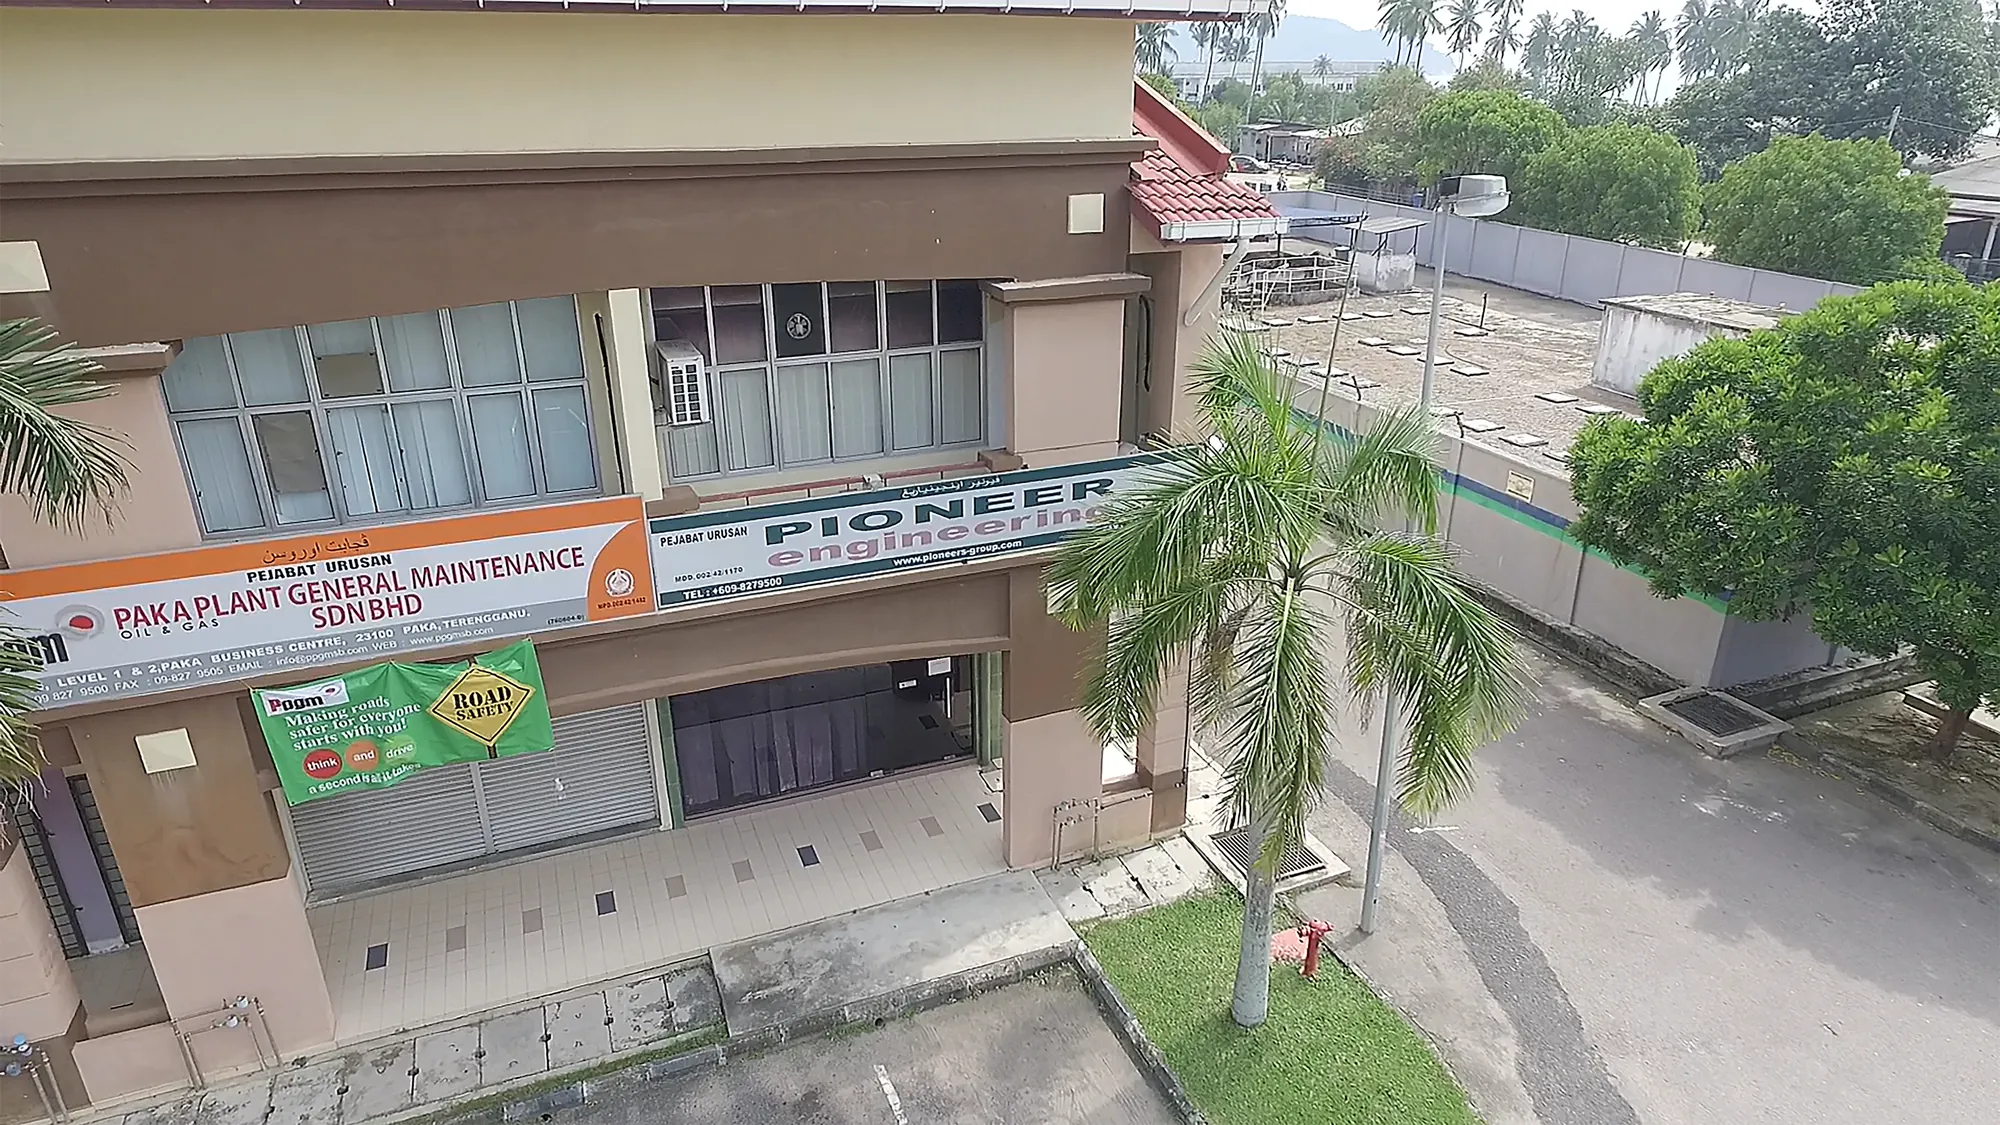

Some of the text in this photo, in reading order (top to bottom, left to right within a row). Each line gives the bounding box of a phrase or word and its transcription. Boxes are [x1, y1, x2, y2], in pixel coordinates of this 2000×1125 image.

[764, 478, 1114, 546] PIONEER
[659, 526, 748, 548] PEJABAT URUSAN
[892, 538, 1023, 567] www.pioneers-group.com
[246, 553, 393, 583] PEJABAT URUSAN
[112, 546, 586, 631] PAKA PLANT GENERAL MAINTENANCE
[311, 593, 423, 629] SDN BHD
[120, 618, 220, 640] OIL & GAS
[57, 672, 107, 688] LEVEL
[113, 669, 122, 679] 1
[131, 666, 143, 676] &
[210, 645, 284, 664] BUSINESS
[288, 636, 347, 653] CENTRE,
[355, 628, 394, 643] 23100
[442, 608, 531, 629] TERENGGANU.
[52, 689, 73, 700] 827
[80, 685, 109, 697] 9500
[115, 679, 139, 691] FAX
[196, 667, 224, 679] 9505
[229, 660, 263, 674] EMAIL
[372, 640, 398, 652] WEB
[410, 626, 494, 645] www.ppgmsb.com
[285, 695, 391, 729] Making roads
[452, 685, 513, 710] ROAD
[456, 700, 515, 722] SAFETY
[289, 703, 421, 741] safer for everyone
[293, 717, 408, 752] starts with you!
[306, 755, 339, 772] think
[352, 749, 376, 762] and
[385, 742, 415, 759] drive
[308, 784, 318, 795] a
[318, 773, 361, 793] second
[361, 772, 370, 783] is
